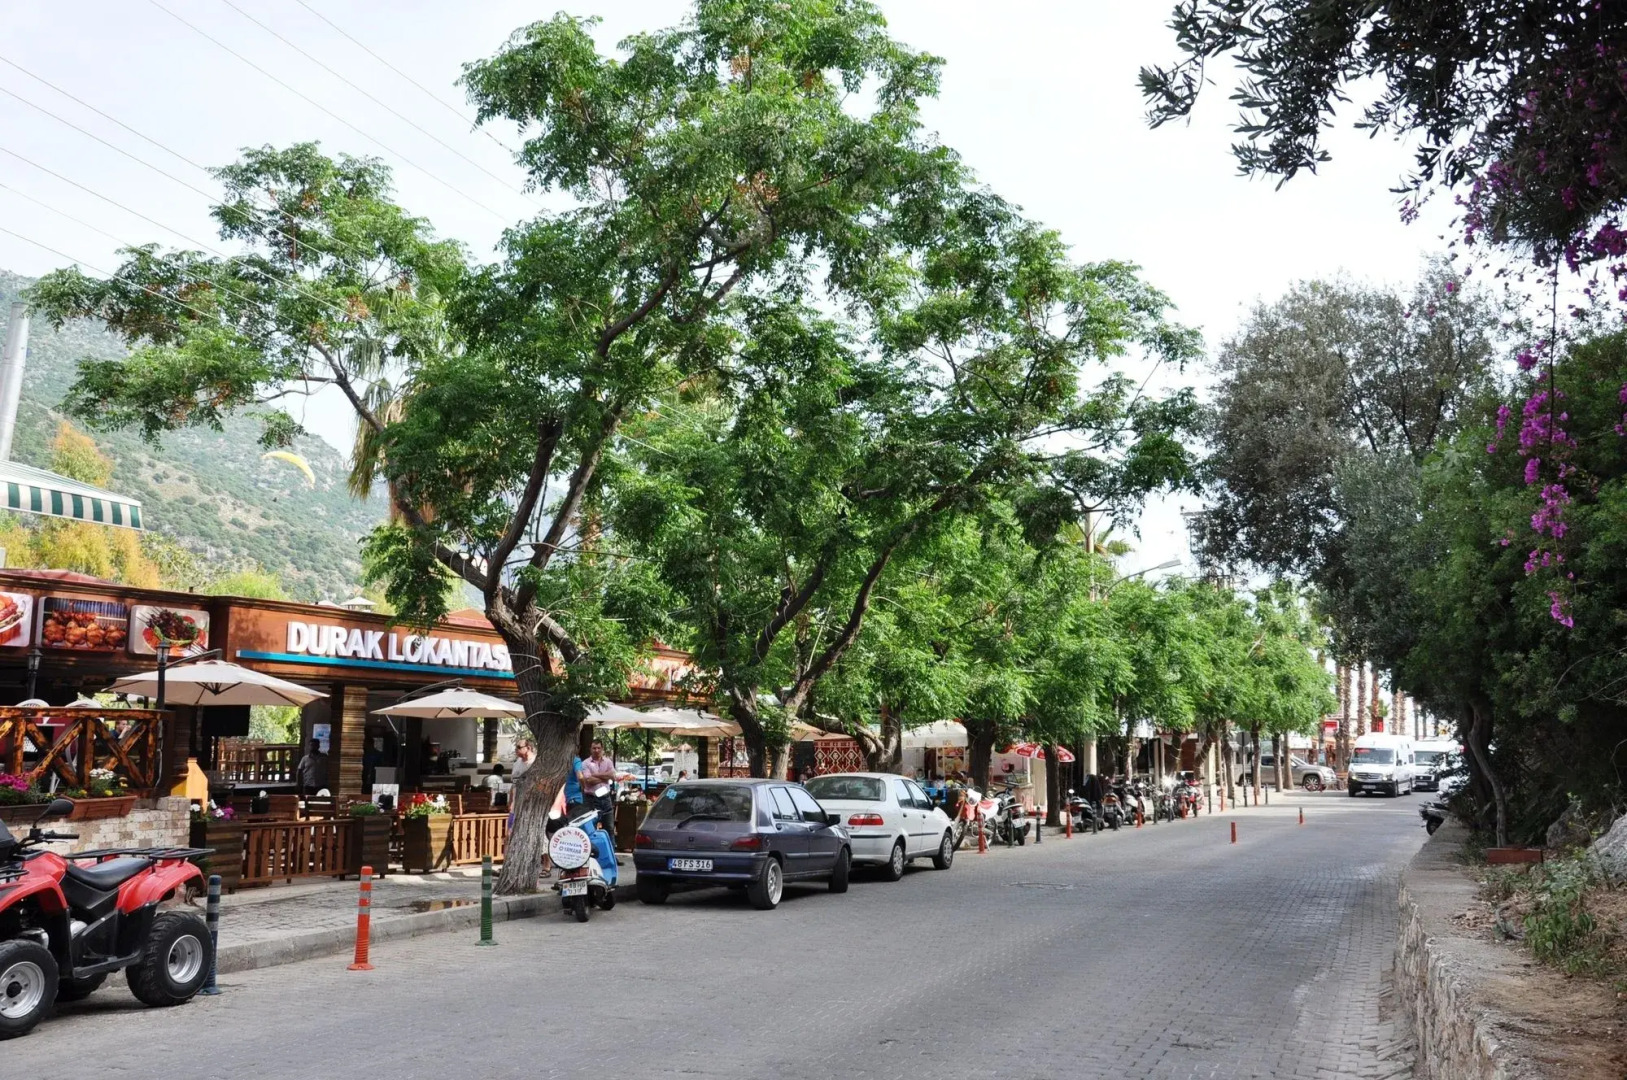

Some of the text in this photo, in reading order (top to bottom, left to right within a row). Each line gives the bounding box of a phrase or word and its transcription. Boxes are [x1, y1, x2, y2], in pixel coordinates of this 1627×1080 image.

[287, 621, 385, 660] DURAK
[574, 830, 589, 854] MOTOR
[672, 859, 711, 869] 48 FS 316
